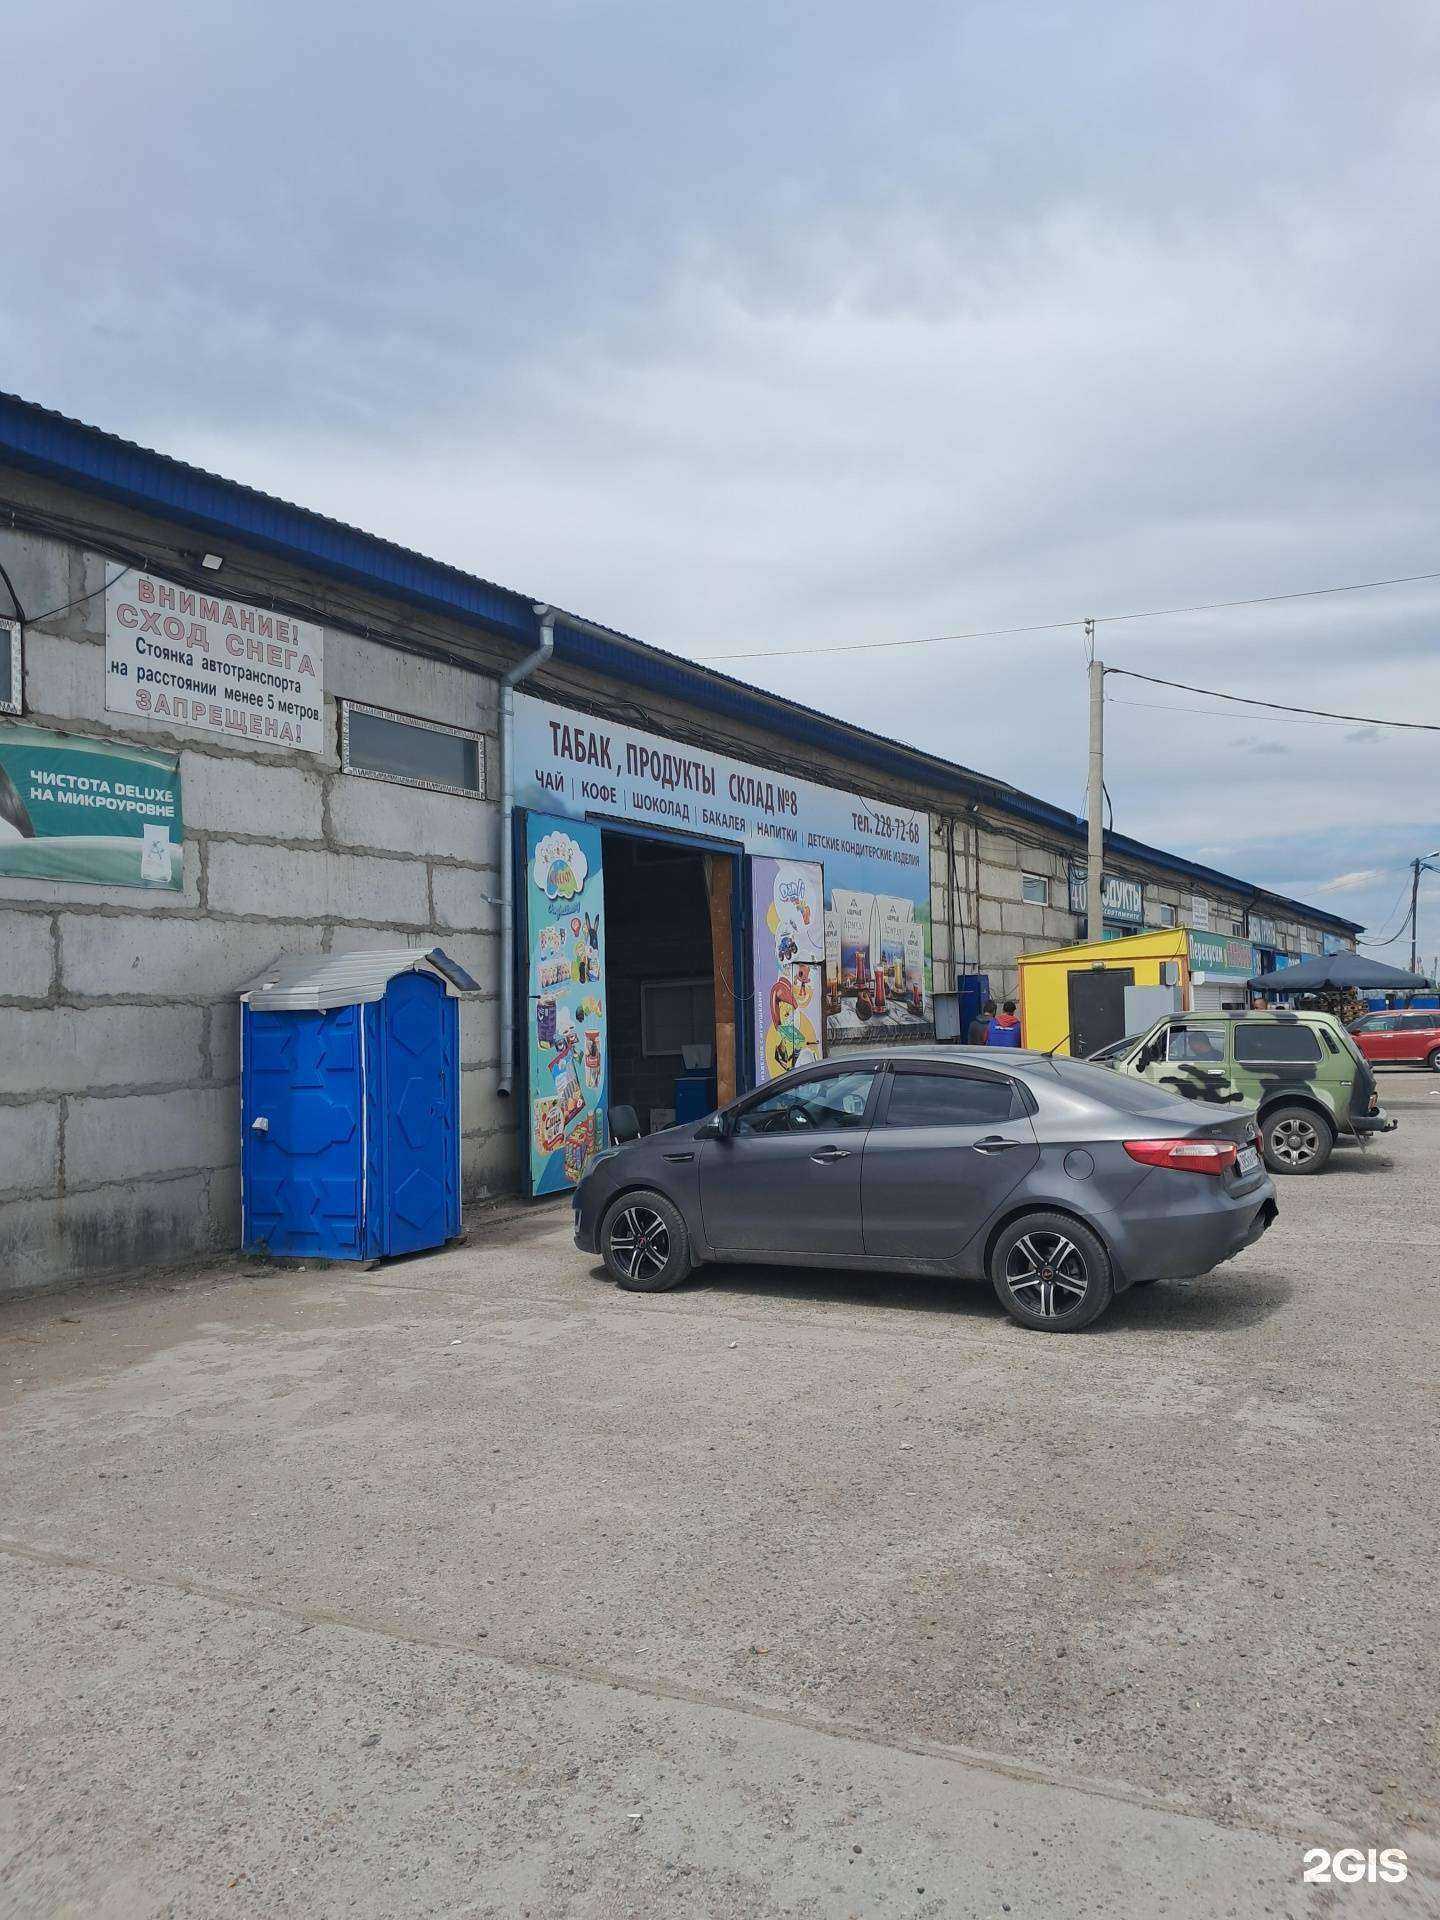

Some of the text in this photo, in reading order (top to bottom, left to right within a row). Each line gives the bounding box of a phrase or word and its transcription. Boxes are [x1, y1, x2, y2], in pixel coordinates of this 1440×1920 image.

[116, 603, 316, 678] СХОД СНЕГА
[138, 578, 300, 646] ВНИМАНИЕ!
[111, 660, 128, 676] на
[136, 665, 217, 697] расстоянии
[224, 686, 264, 708] менее
[267, 694, 275, 710] 5
[135, 636, 301, 694] Стоянка автотранспорта
[135, 688, 302, 744] ЗАПРЕЩЕНА!
[30, 769, 175, 803] ЧИСТОТА DELUXE
[30, 787, 175, 817] НА МИКРОУРОВНЕ
[626, 742, 716, 796] ПРОДУКТЫ
[728, 773, 775, 817] СКЛАД
[777, 785, 798, 817] №8
[535, 769, 920, 868] ЧАЙ КОФЕ ШОКОЛАД БАКАЛЕЯ НАПИТКИ ДЕТСКИЕ КОНДИТЕРСКИЕ ИЗДЕЛИЯ
[851, 812, 920, 845] тел. 228-72-68
